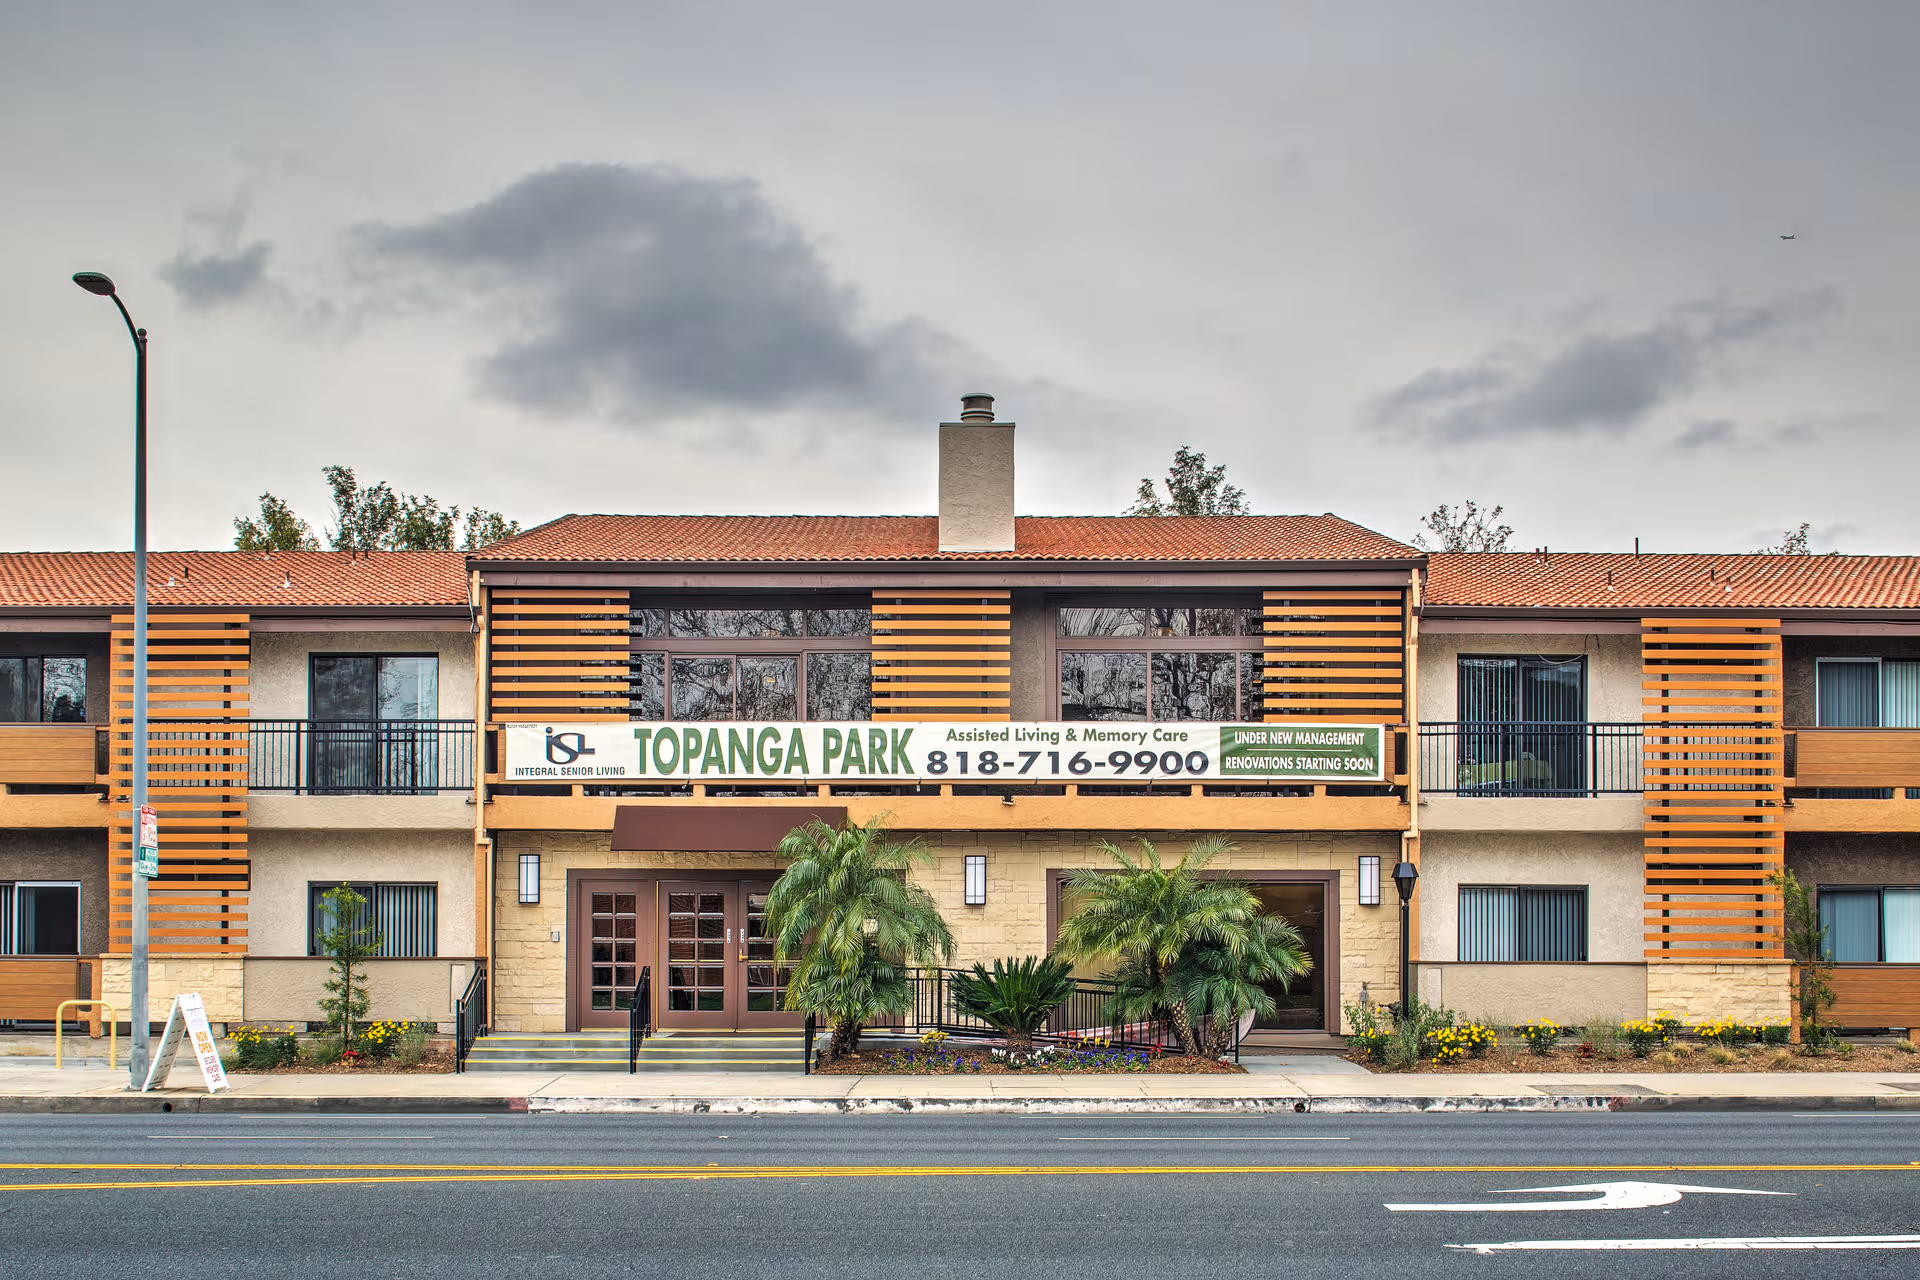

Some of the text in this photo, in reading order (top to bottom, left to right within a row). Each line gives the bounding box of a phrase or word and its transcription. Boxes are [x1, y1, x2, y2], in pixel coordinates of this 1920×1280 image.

[946, 728, 1189, 746] Assisted Living & Memory Care
[1234, 731, 1365, 746] UNDER NEW MANAGEMENT
[634, 727, 915, 776] TOPANGA PARK
[515, 766, 625, 776] INTEGRAL SENIOR LIVING
[926, 751, 1210, 775] 818-716-9900
[1225, 756, 1374, 771] RENOVATIONS STARTING SOON
